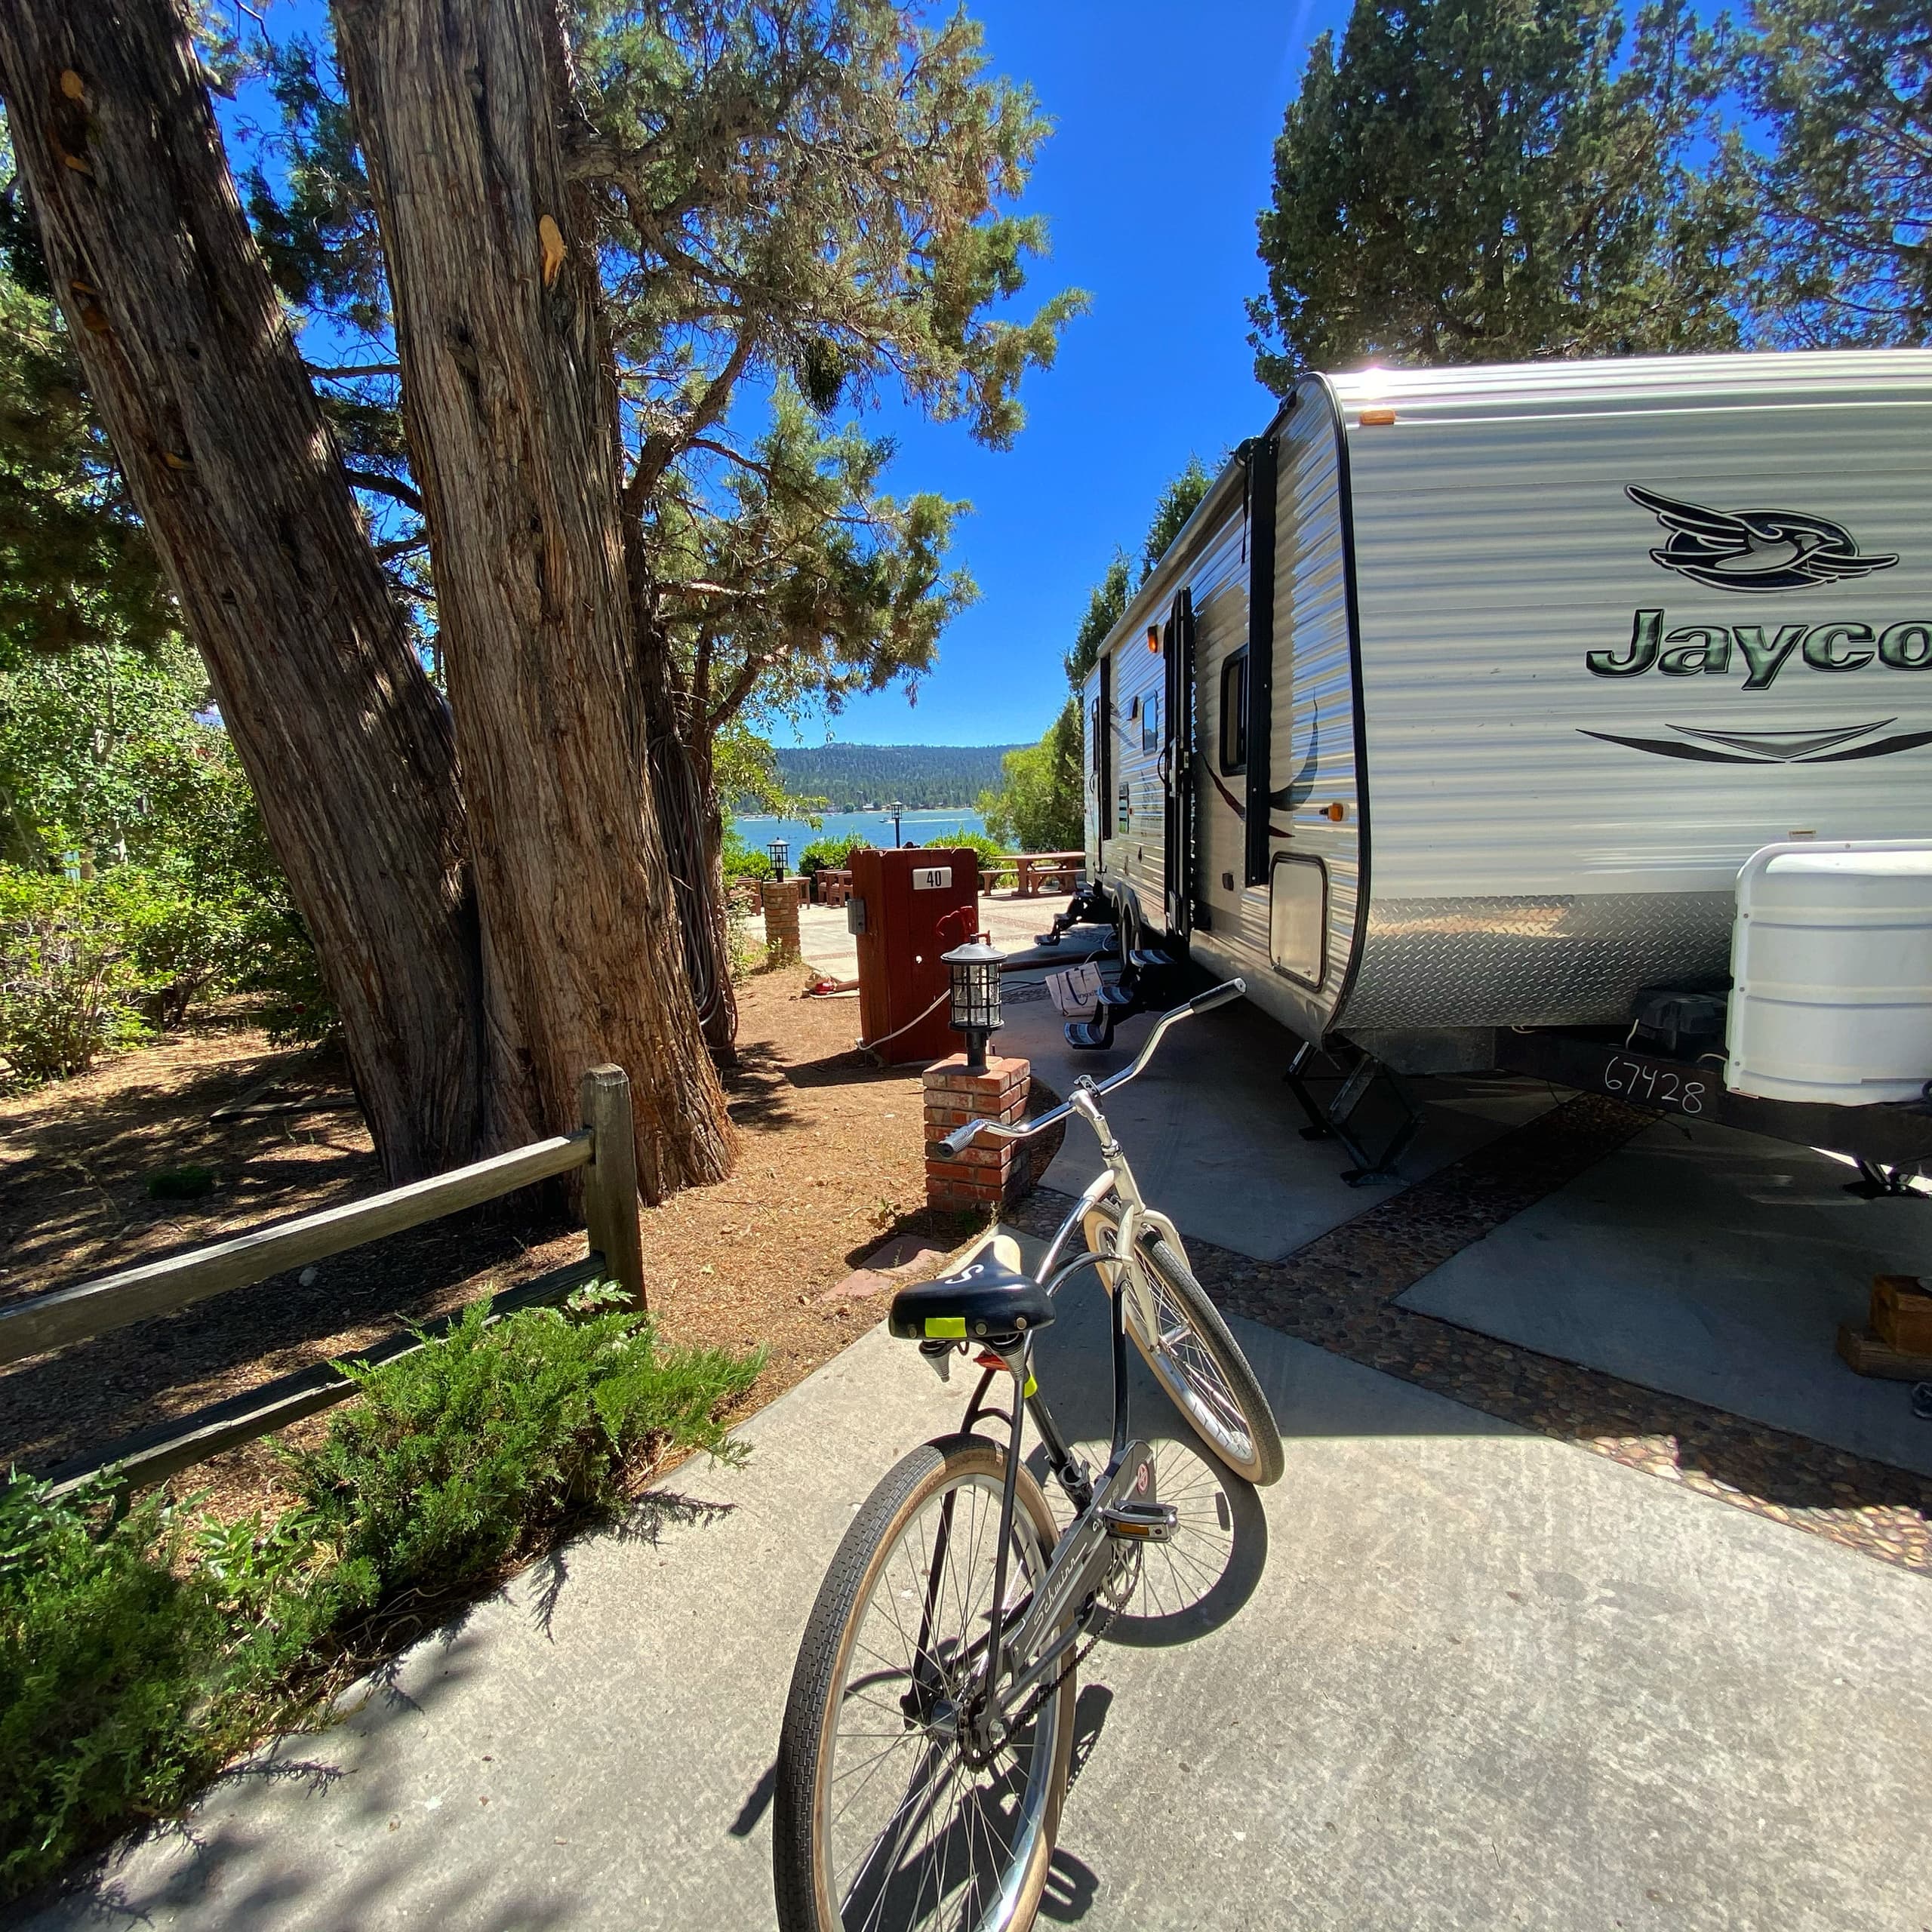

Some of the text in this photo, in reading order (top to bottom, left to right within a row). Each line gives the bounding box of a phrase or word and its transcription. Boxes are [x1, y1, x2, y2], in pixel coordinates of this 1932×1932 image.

[1586, 608, 1932, 691] Jayco
[927, 870, 942, 888] 40
[1604, 1057, 1705, 1113] 67428
[1029, 1541, 1088, 1632] Schwinn
